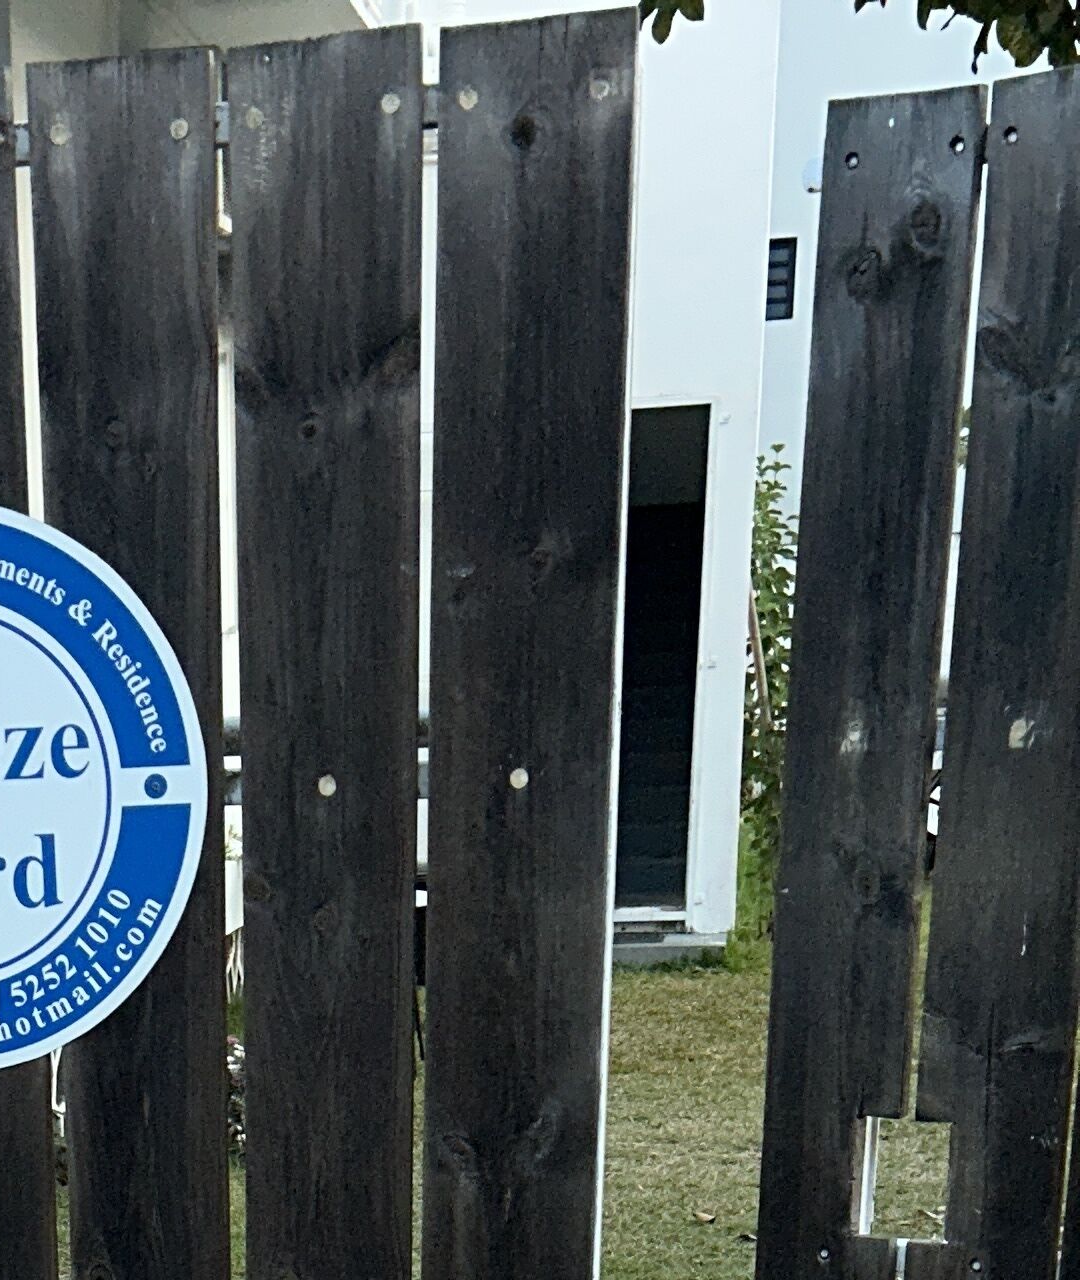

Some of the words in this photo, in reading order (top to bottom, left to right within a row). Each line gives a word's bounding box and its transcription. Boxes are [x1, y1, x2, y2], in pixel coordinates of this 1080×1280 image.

[68, 599, 92, 626] &
[91, 619, 167, 754] Residence
[10, 954, 77, 1007] 5252
[75, 889, 131, 959] 1010
